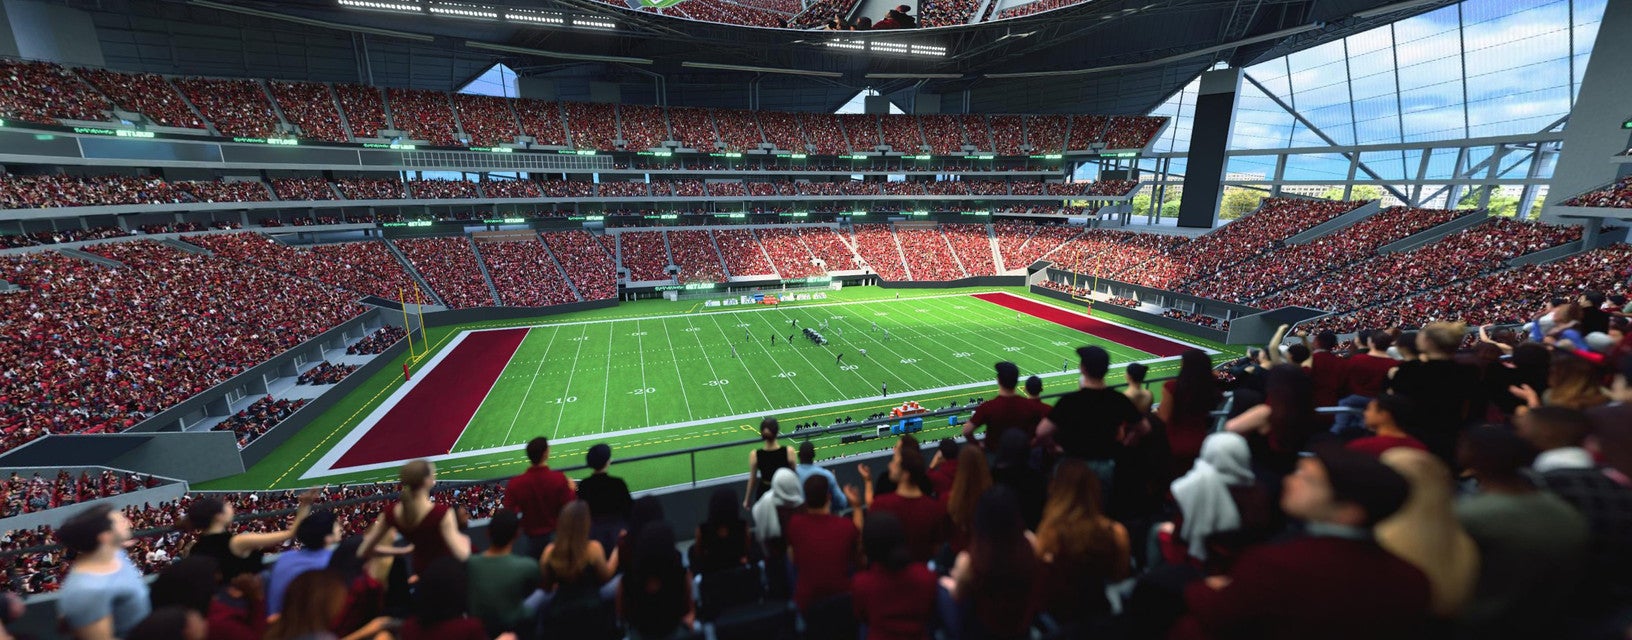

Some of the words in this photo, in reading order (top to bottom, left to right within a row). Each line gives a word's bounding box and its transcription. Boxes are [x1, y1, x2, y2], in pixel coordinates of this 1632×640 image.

[708, 379, 729, 387] 30
[633, 387, 656, 395] 20
[554, 396, 577, 404] 10
